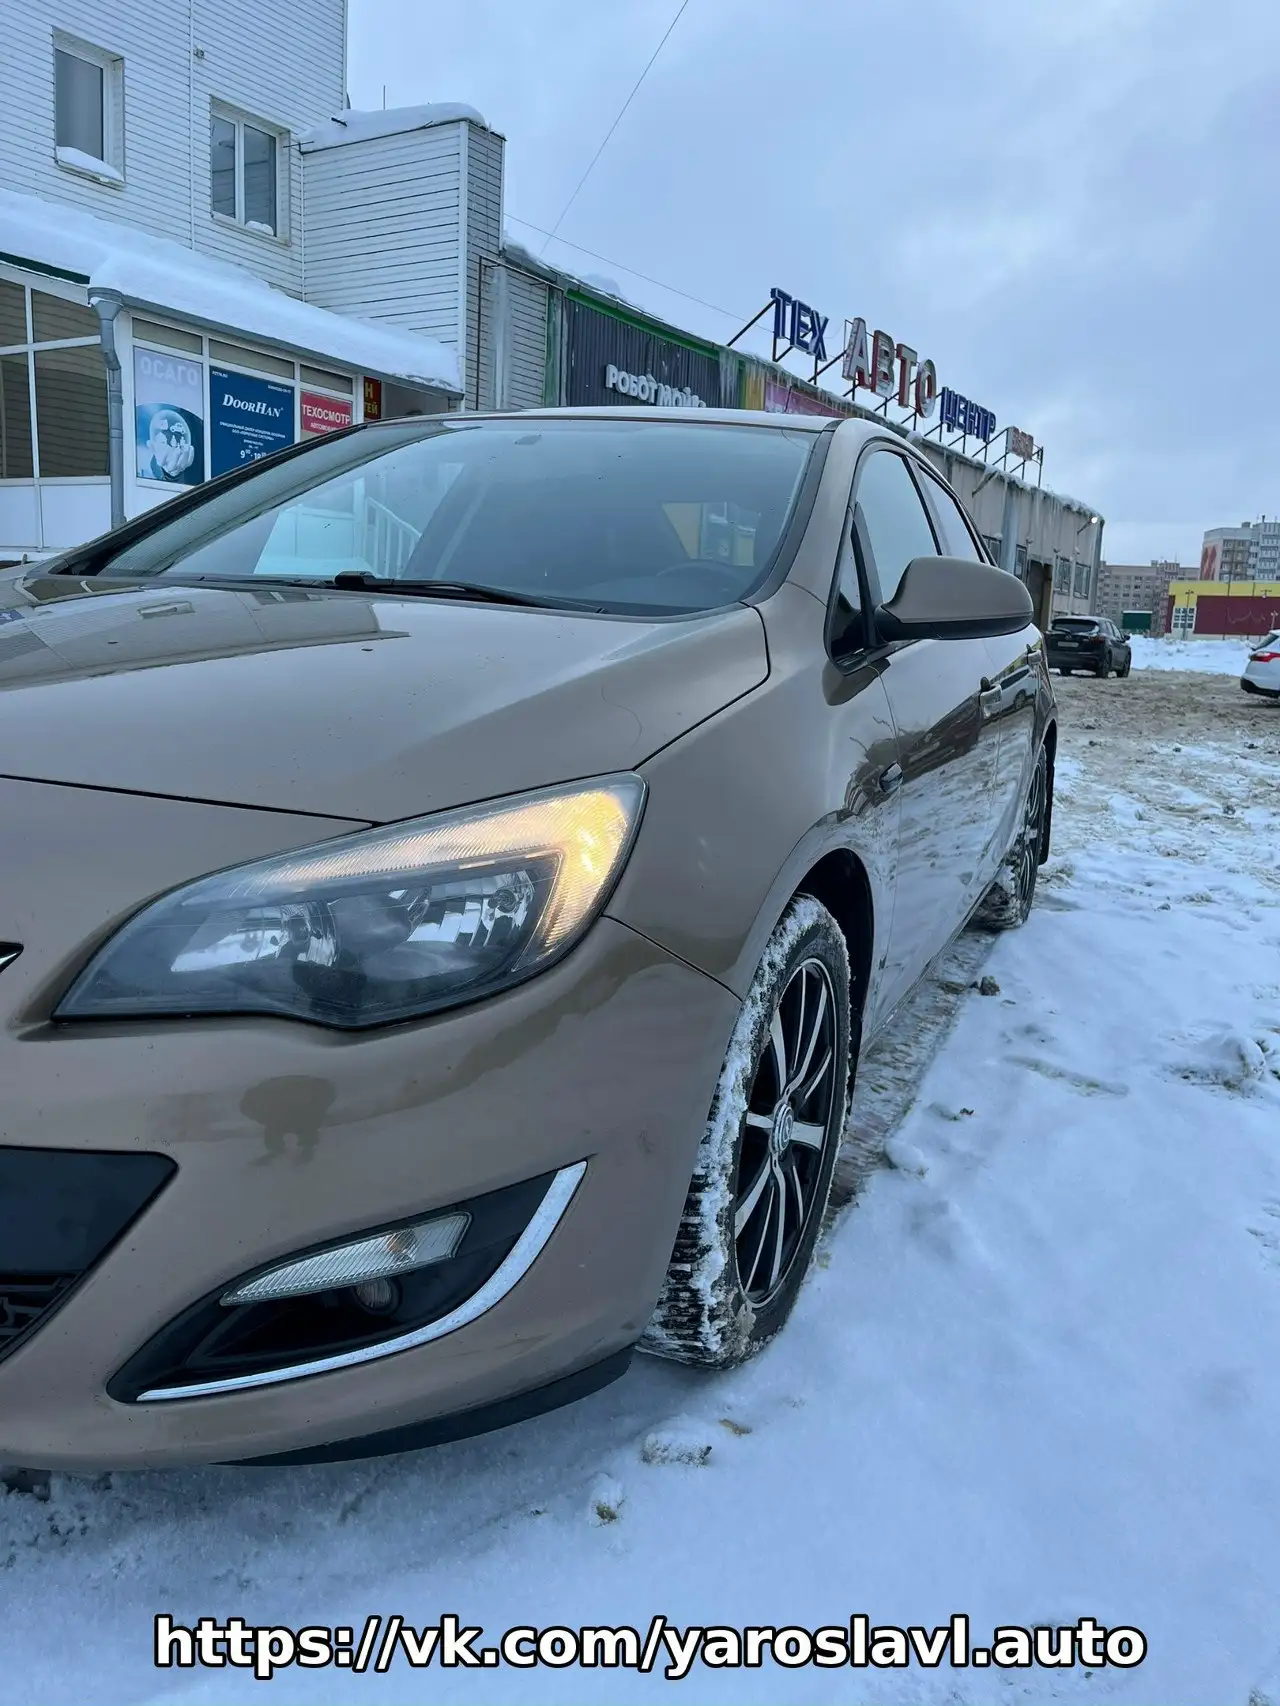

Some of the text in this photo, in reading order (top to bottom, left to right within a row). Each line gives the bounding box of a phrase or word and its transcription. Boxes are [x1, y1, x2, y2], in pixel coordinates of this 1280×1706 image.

[139, 356, 199, 387] ОСАГО
[770, 287, 997, 443] ТЕХ АВТО ЦЕНТР
[605, 363, 658, 404] РОБОТ
[301, 404, 351, 425] ТЕХОСМОТР
